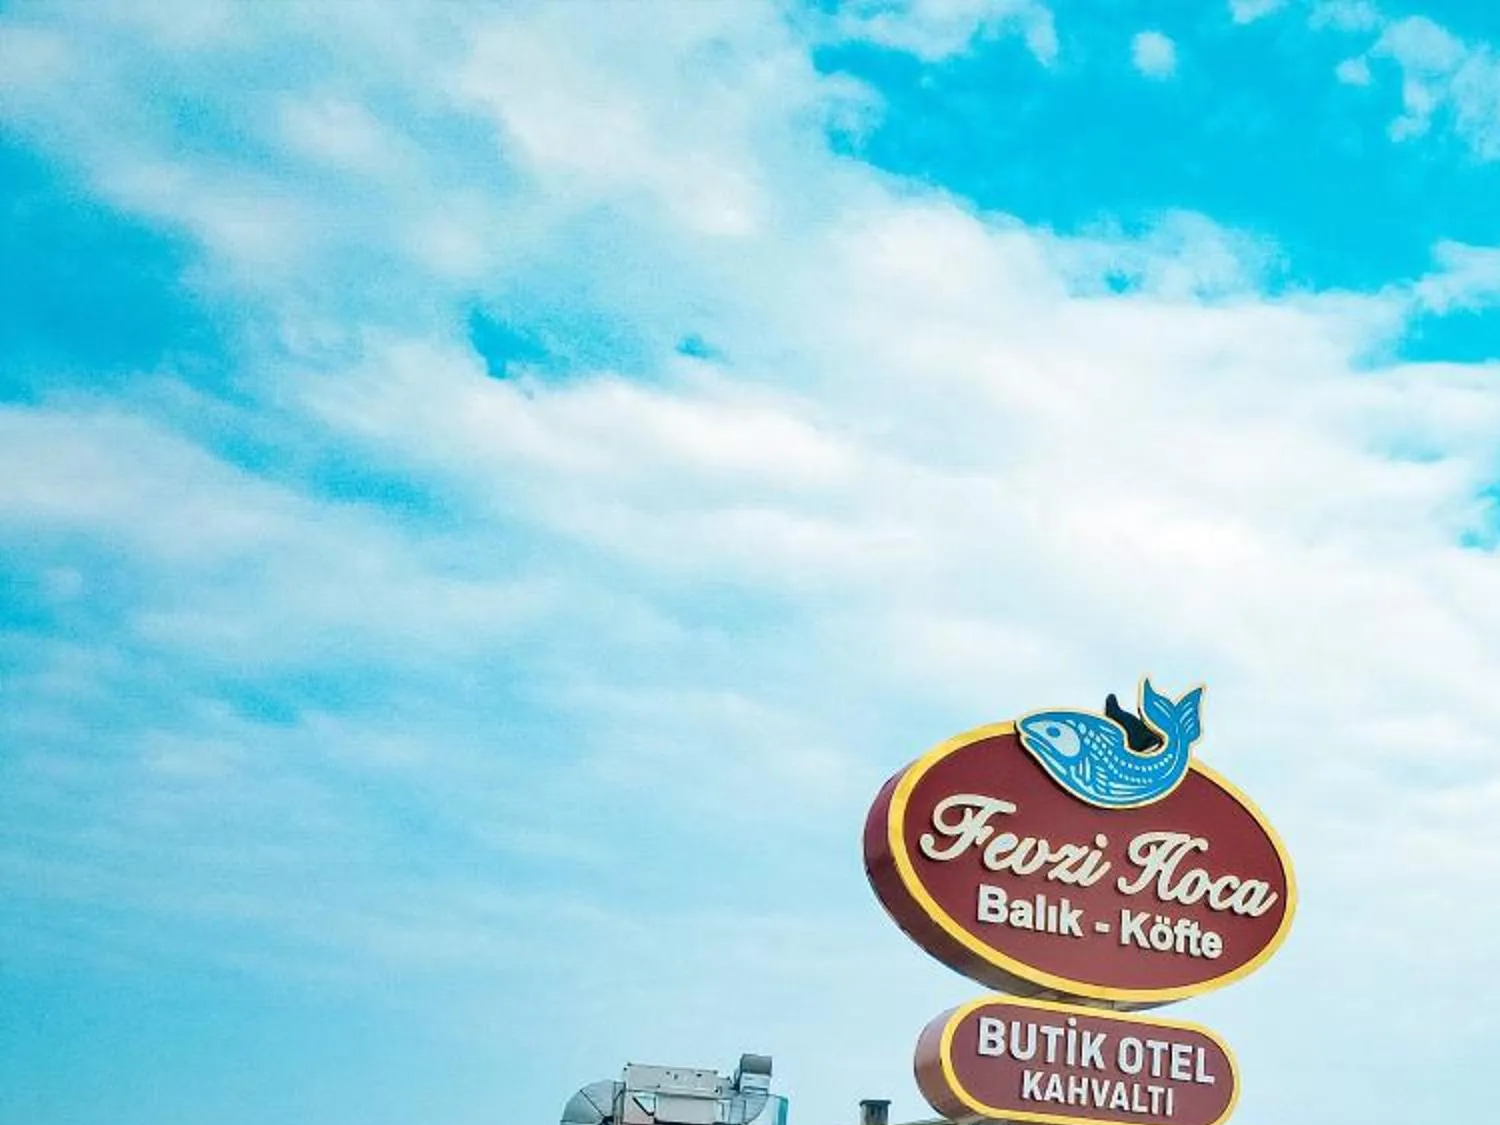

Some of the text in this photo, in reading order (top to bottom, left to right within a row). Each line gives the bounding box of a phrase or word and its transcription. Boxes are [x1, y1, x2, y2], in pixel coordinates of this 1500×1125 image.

[919, 793, 1279, 918] Fevzi Hoca
[977, 884, 1085, 938] Balık
[1120, 909, 1224, 959] Köfte
[977, 1017, 1216, 1085] BUTİK OTEL
[1021, 1069, 1174, 1117] KAHVALTI
